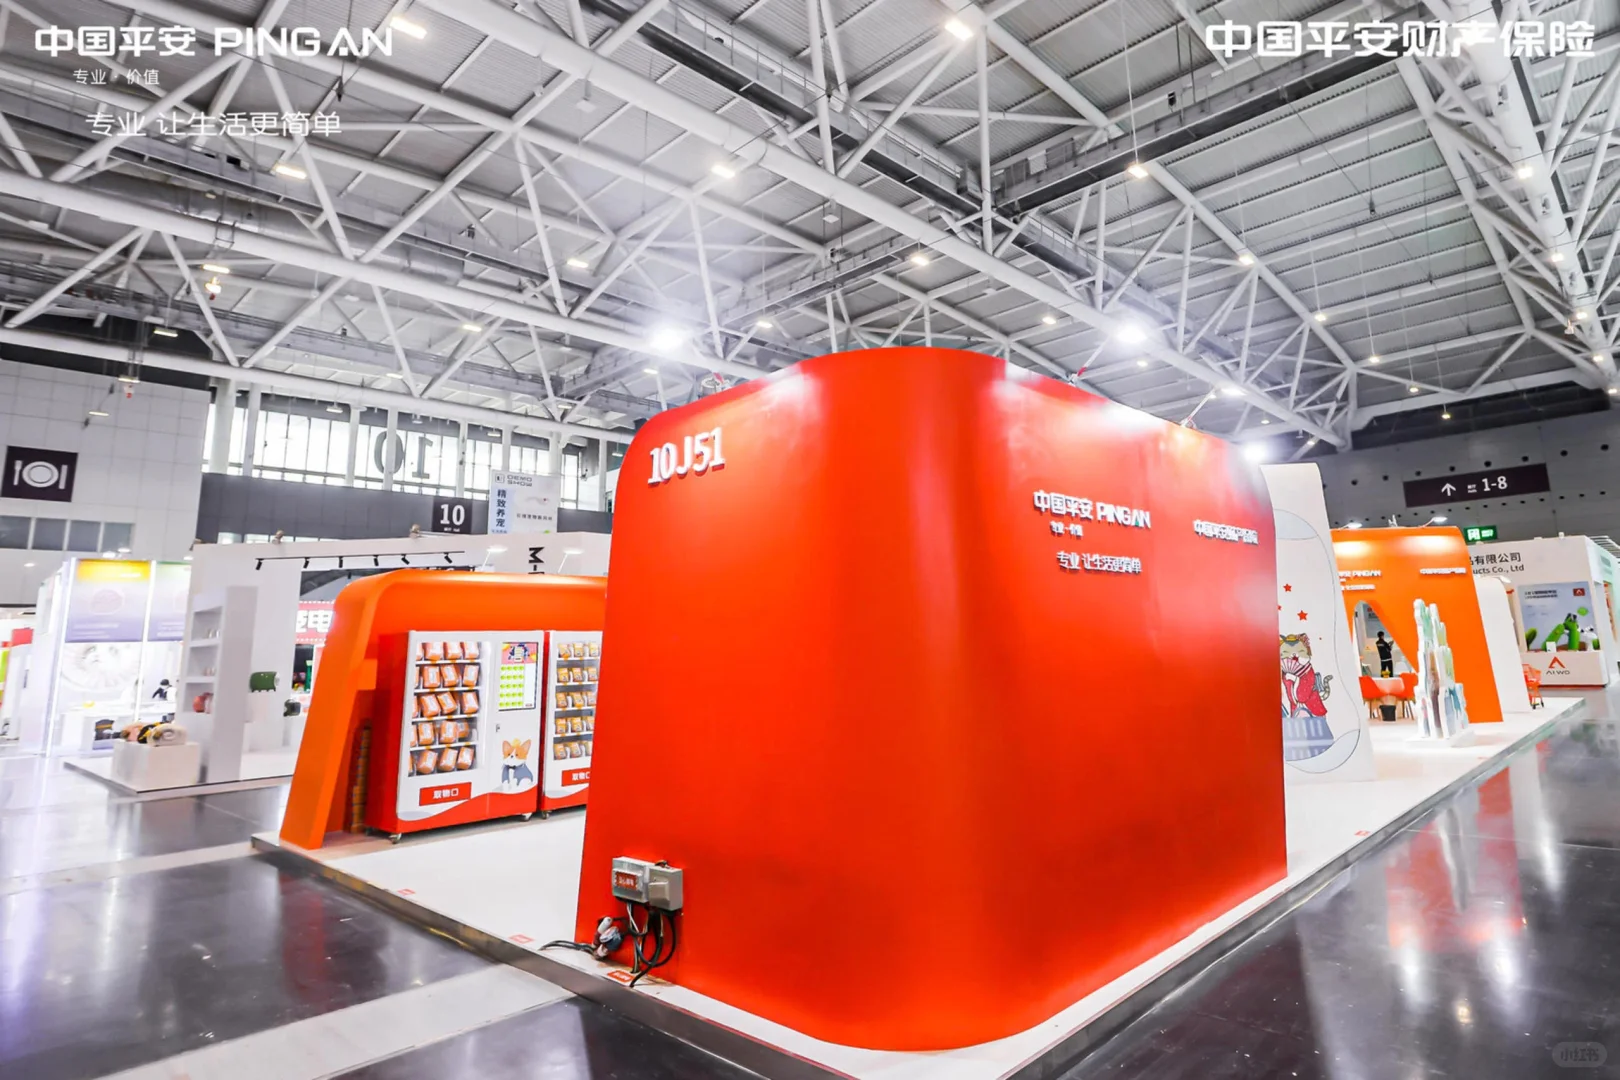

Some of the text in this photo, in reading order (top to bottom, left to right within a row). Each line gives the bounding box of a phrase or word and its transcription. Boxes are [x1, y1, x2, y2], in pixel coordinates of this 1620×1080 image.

[648, 427, 726, 485] 10J51
[1482, 476, 1508, 492] 1-8
[440, 503, 466, 526] 10
[496, 489, 507, 528] 精致养宠
[1033, 490, 1093, 520] 中国平安
[1057, 551, 1142, 574] 专业 让生活更简单
[1510, 564, 1525, 572] Ltd
